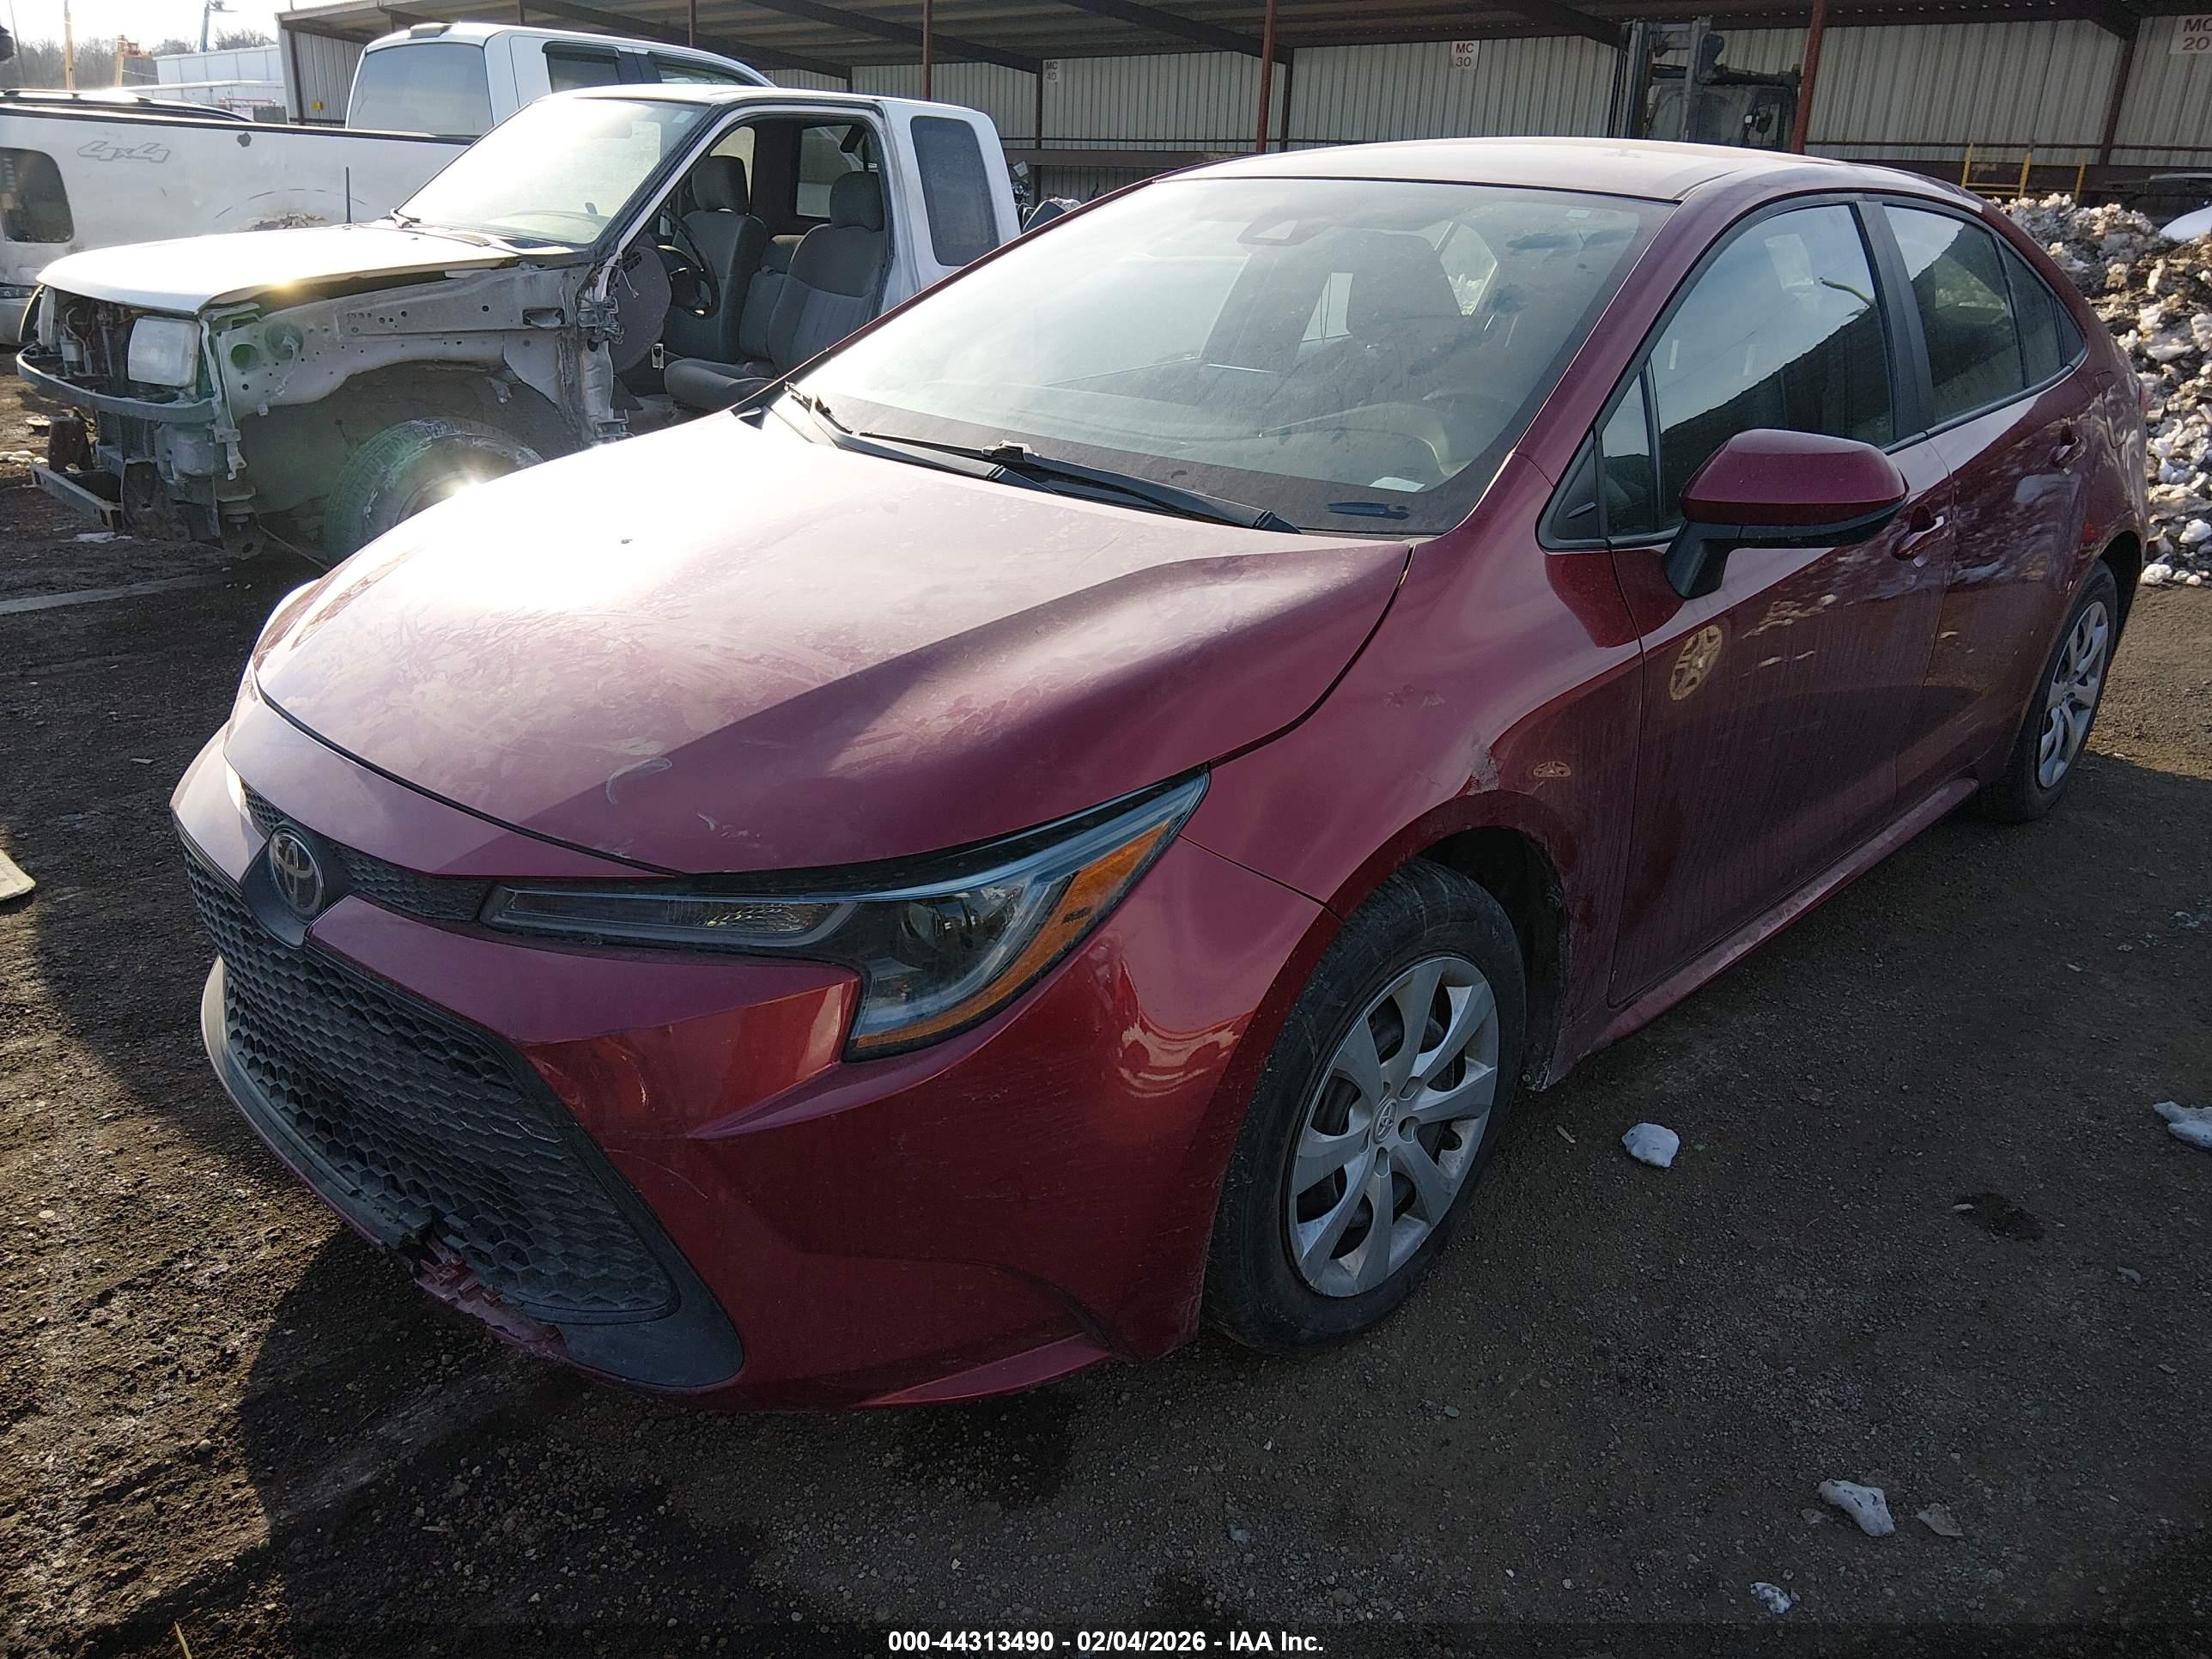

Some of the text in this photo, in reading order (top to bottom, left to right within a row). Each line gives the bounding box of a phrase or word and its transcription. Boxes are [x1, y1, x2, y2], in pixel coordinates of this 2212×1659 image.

[1455, 43, 1474, 53] MC
[2182, 36, 2210, 51] 20
[1455, 57, 1471, 67] 30
